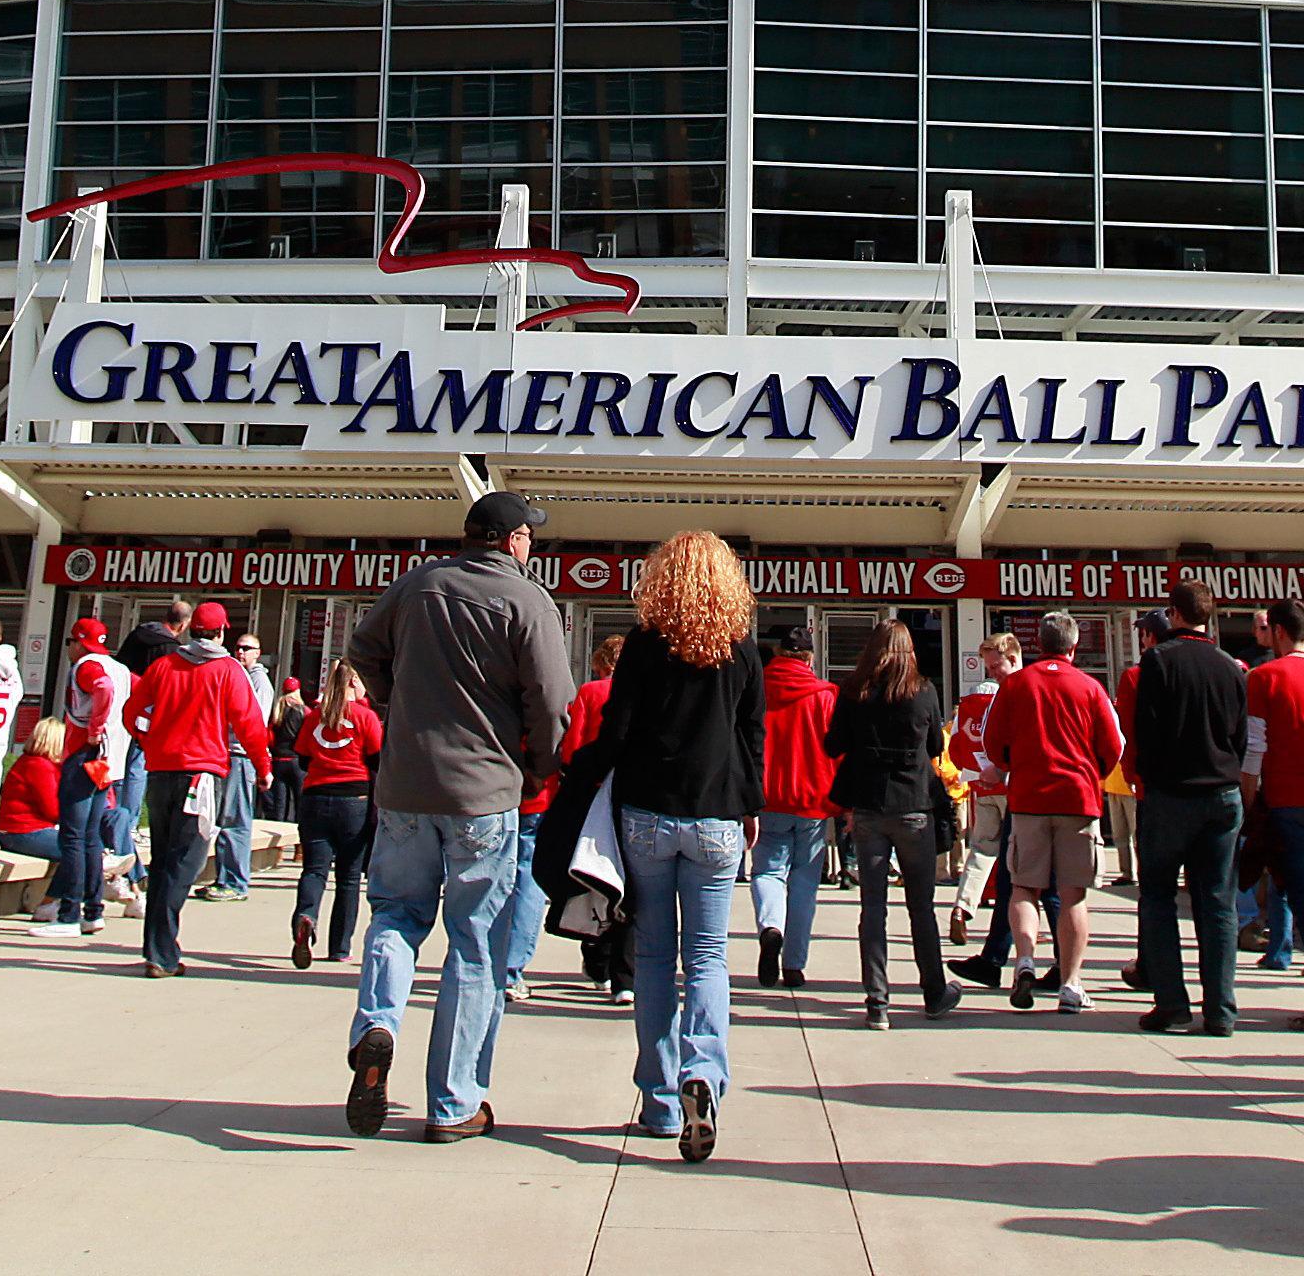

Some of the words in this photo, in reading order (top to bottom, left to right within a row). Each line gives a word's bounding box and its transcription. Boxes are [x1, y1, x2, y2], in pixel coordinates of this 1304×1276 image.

[52, 320, 382, 406] GREAT
[339, 350, 875, 441] AMERICAN
[891, 356, 1146, 446] BALL
[103, 549, 233, 584] HAMILTON
[242, 552, 344, 586] COUNTY
[527, 556, 561, 590] OU
[580, 569, 610, 578] REDS
[741, 560, 849, 594] UXHALL
[858, 561, 916, 595] WAY
[935, 574, 966, 583] REDS
[999, 563, 1073, 597] HOME
[1082, 564, 1112, 598] OF
[1121, 565, 1171, 598] THE
[566, 615, 572, 632] 12
